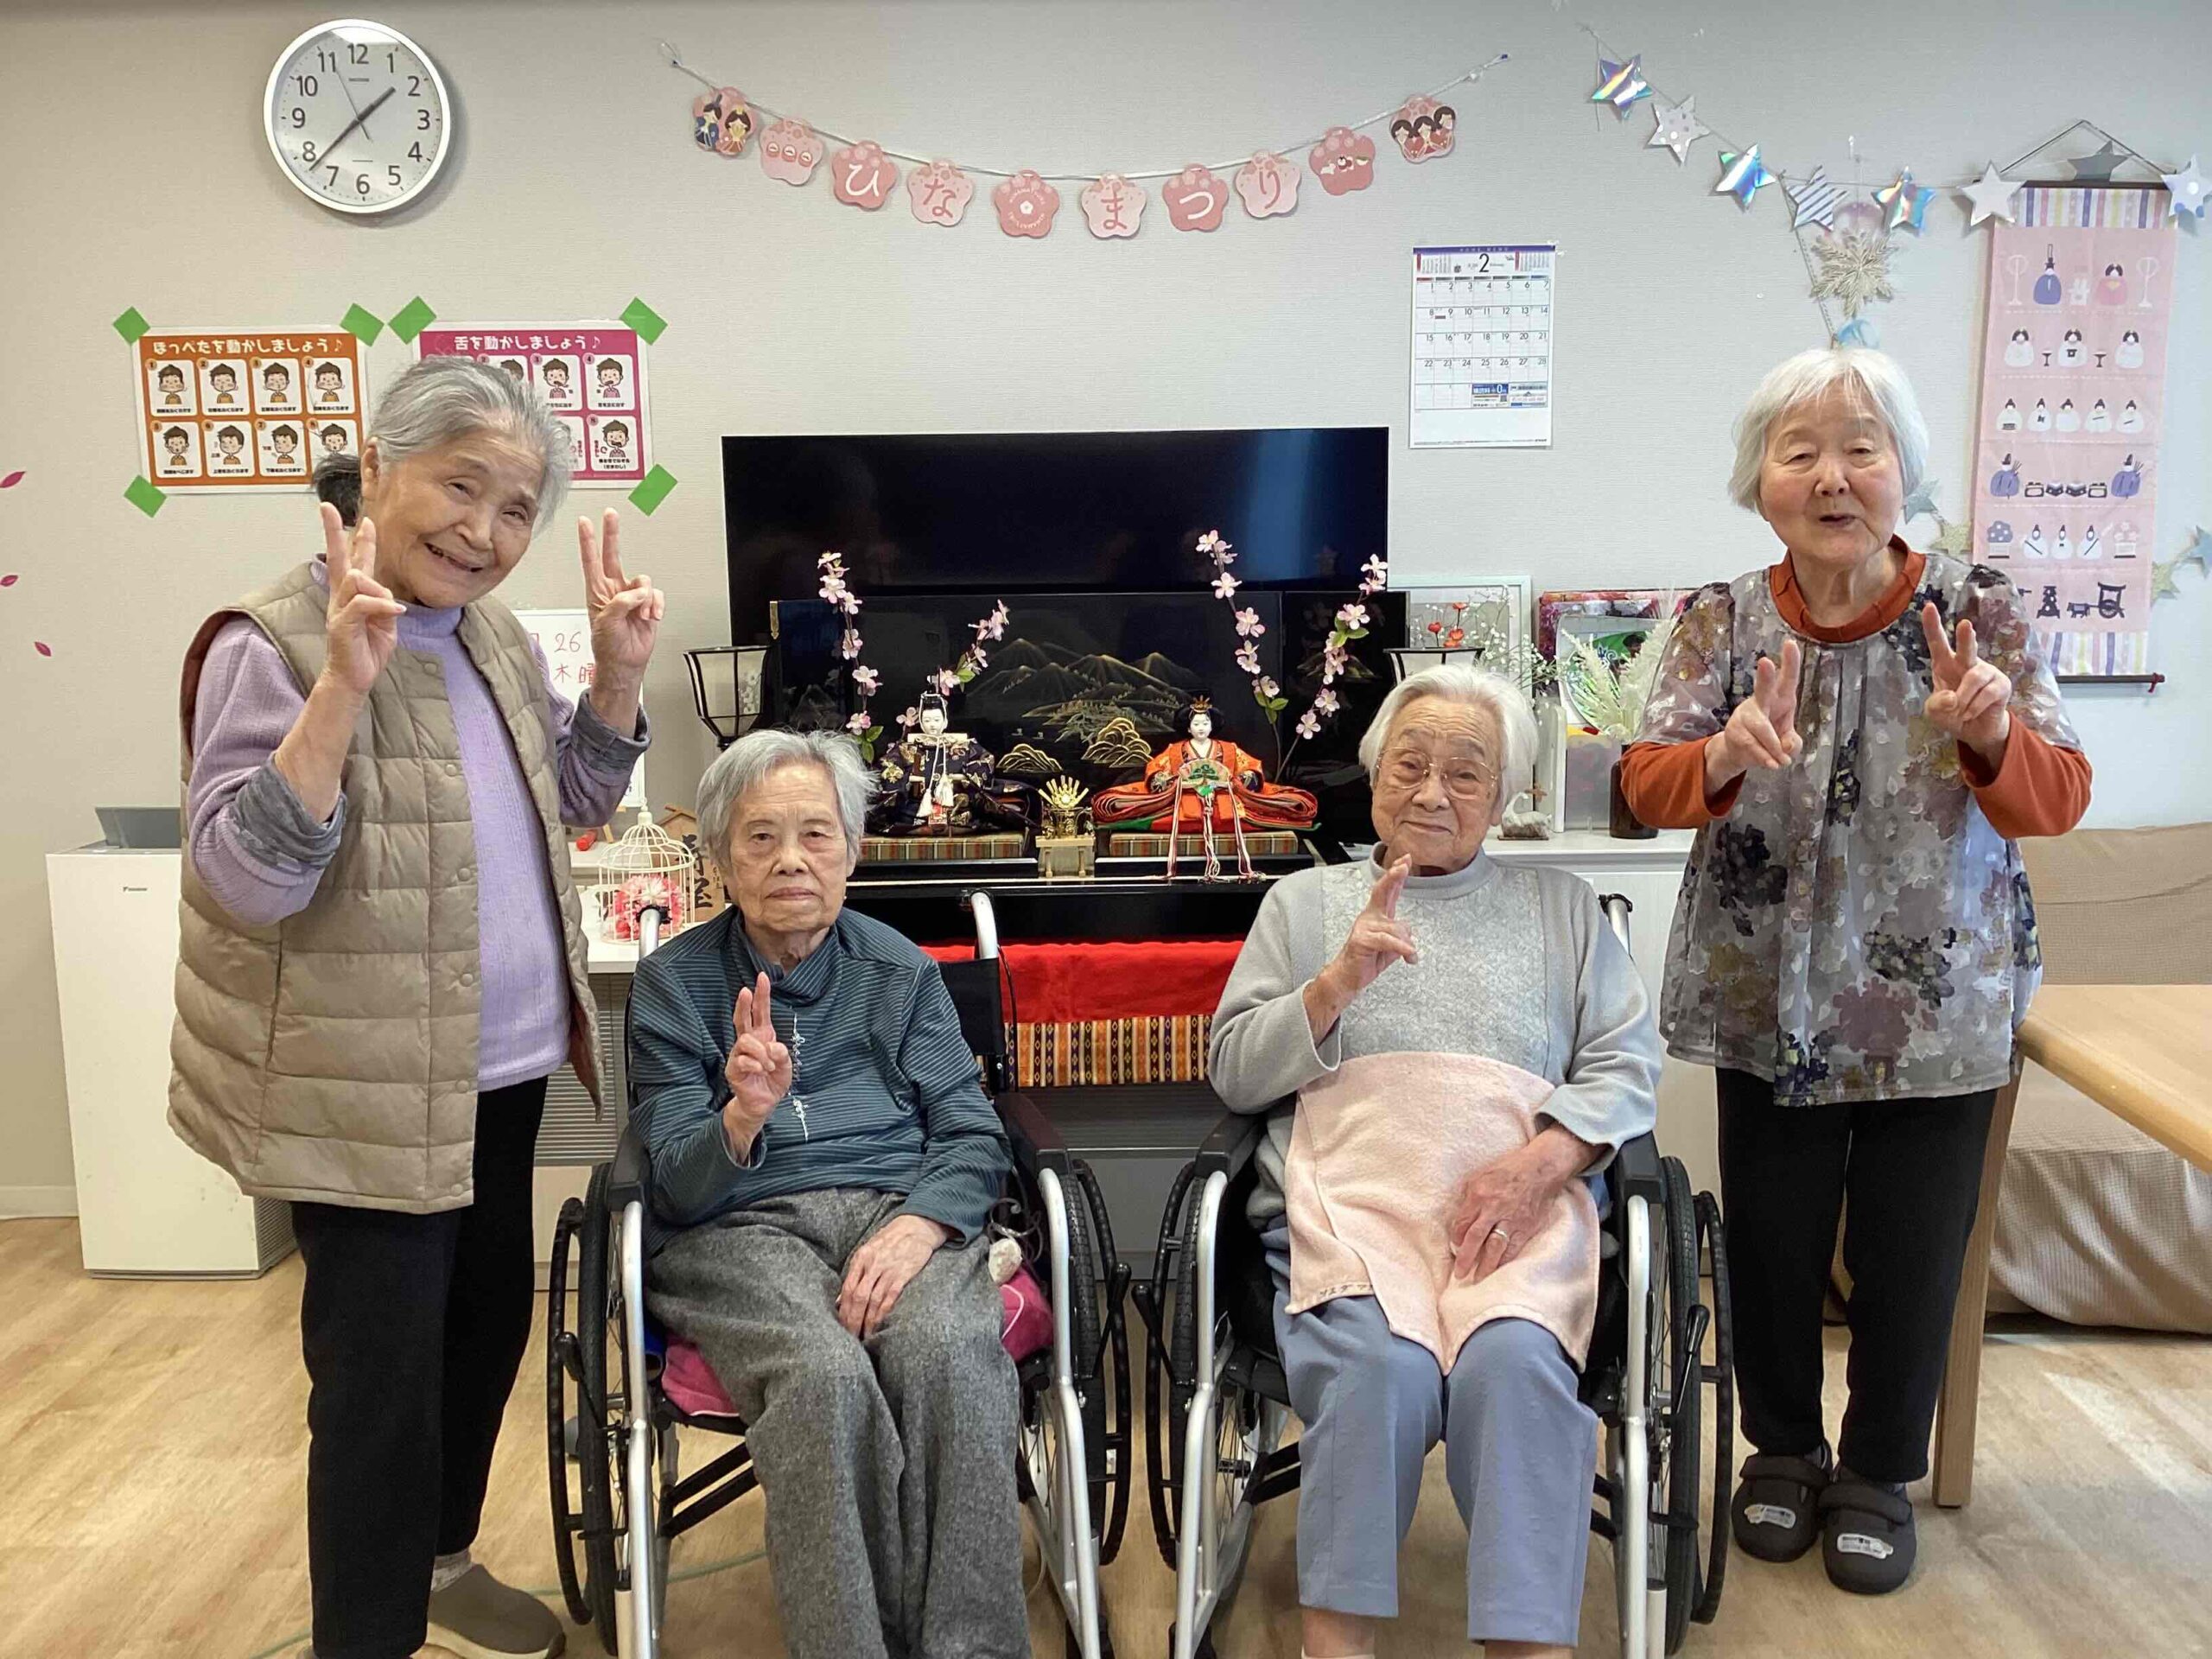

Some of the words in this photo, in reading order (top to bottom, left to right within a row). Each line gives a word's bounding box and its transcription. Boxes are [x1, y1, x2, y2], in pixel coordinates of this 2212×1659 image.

[318, 52, 336, 73] 11
[347, 43, 369, 64] 12
[387, 53, 395, 73] 1
[296, 75, 318, 96] 10
[408, 76, 421, 96] 2
[292, 107, 306, 128] 9
[417, 109, 430, 130] 3
[302, 141, 316, 162] 8
[408, 142, 423, 162] 4
[326, 165, 340, 186] 7
[356, 174, 370, 194] 6
[389, 165, 401, 186] 5
[1479, 253, 1490, 272] 2
[454, 335, 586, 350] 舌を動かしましょう
[554, 632, 582, 652] 26
